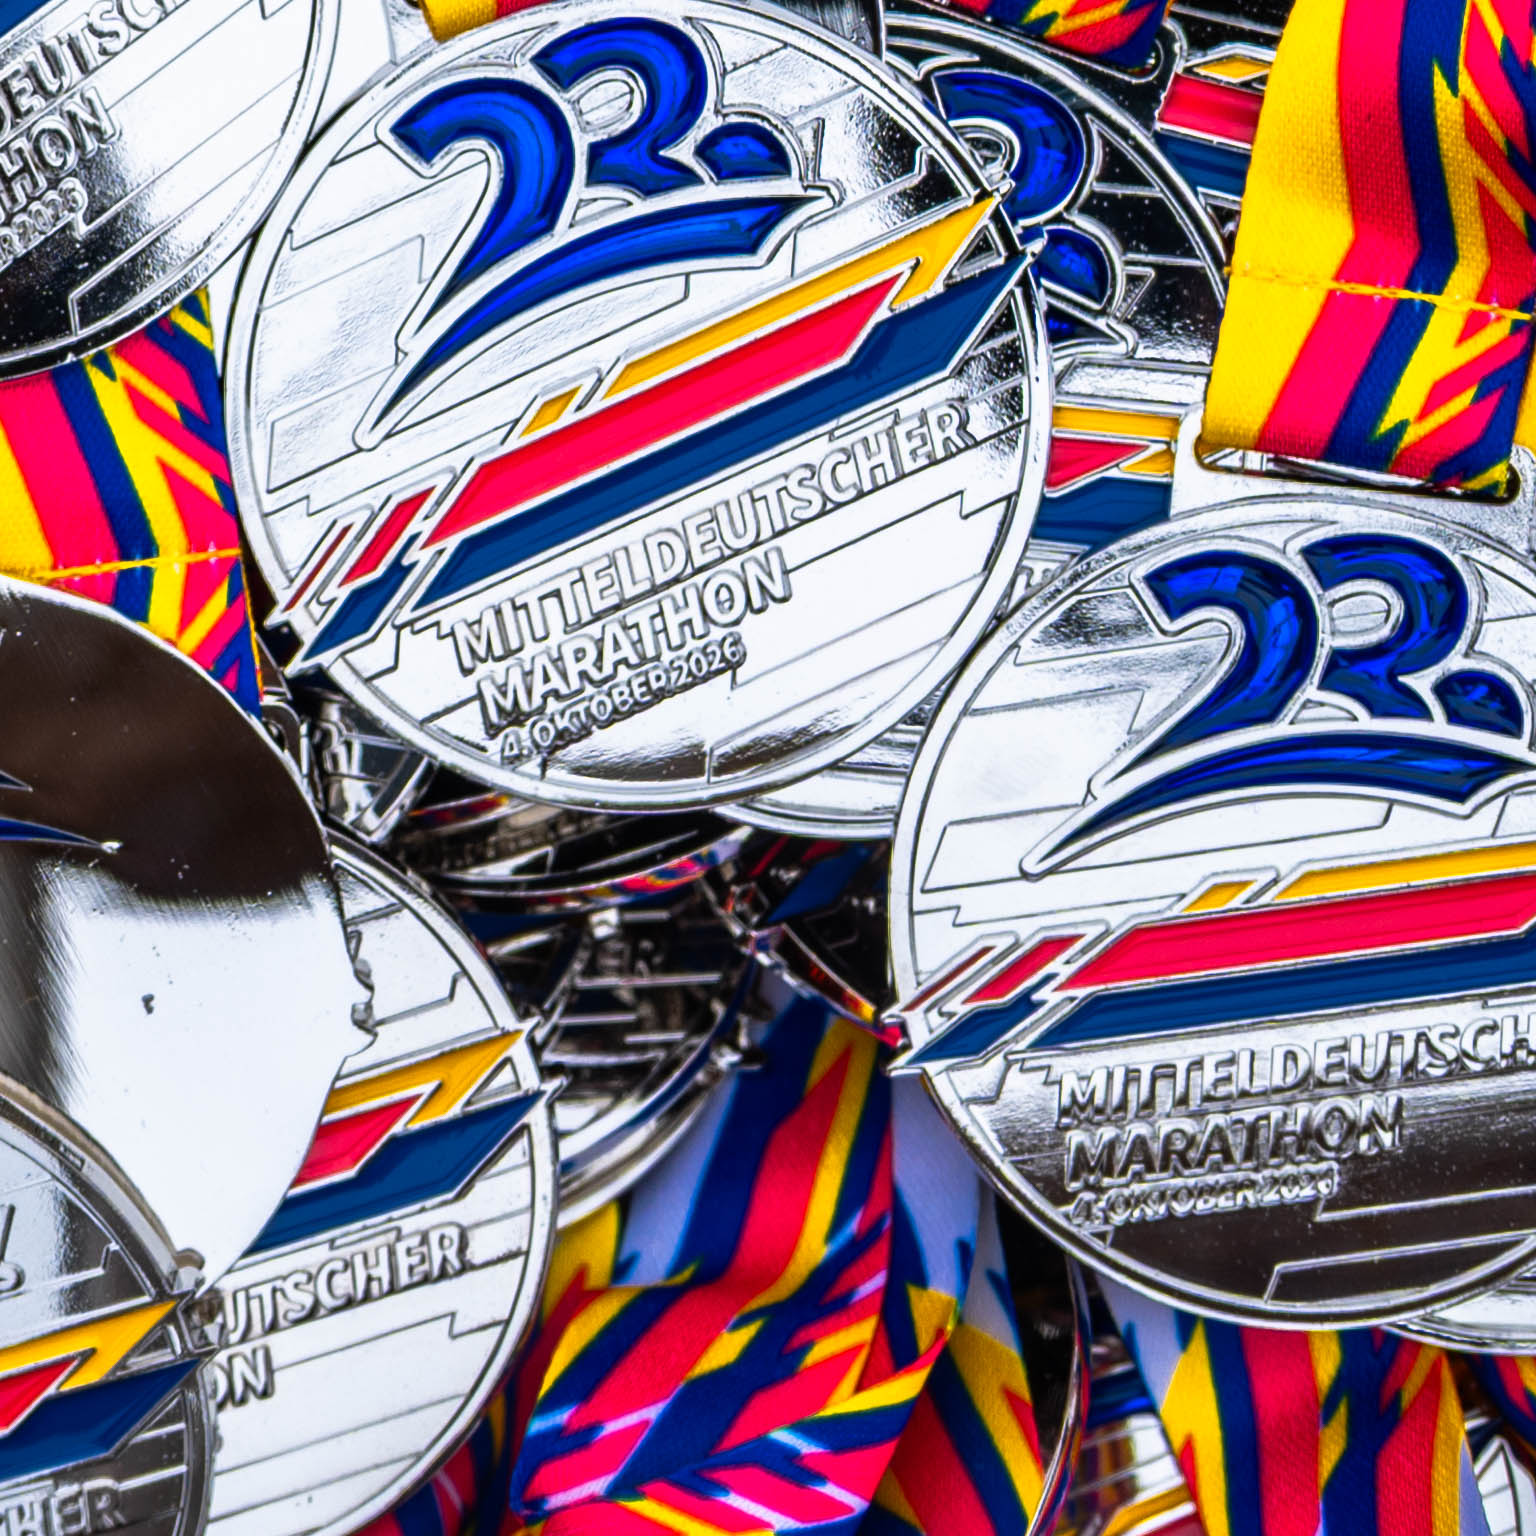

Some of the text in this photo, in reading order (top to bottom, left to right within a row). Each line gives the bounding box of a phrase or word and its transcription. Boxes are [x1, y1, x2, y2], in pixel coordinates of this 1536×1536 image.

[451, 399, 982, 675] MITTELDEUTSCHER
[478, 546, 792, 735] MARATHON
[500, 632, 748, 761] 4. OKTOBER 2026
[1064, 1094, 1405, 1192] MARATHON
